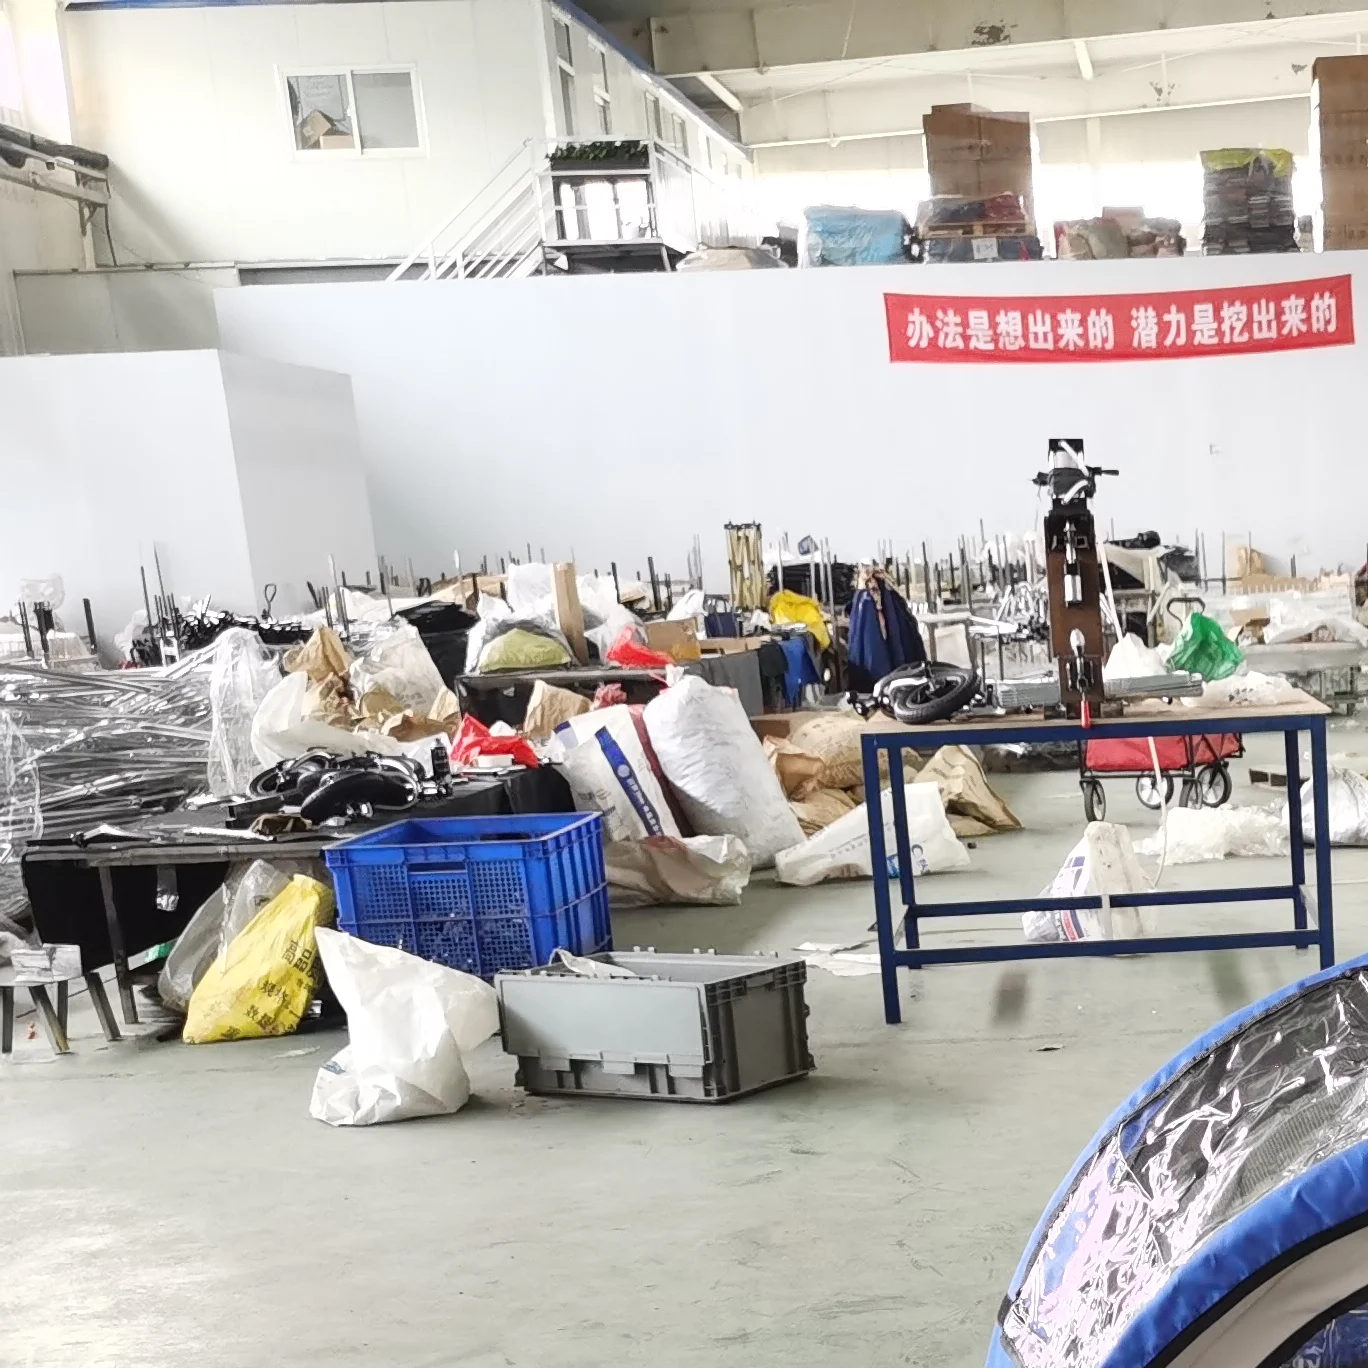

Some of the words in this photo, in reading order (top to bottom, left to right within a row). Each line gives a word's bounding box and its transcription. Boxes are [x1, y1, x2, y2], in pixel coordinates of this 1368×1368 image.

[906, 307, 1115, 350] 办法是想出来的
[1131, 291, 1337, 349] 潜力是挖出来的
[282, 939, 319, 980] 高品
